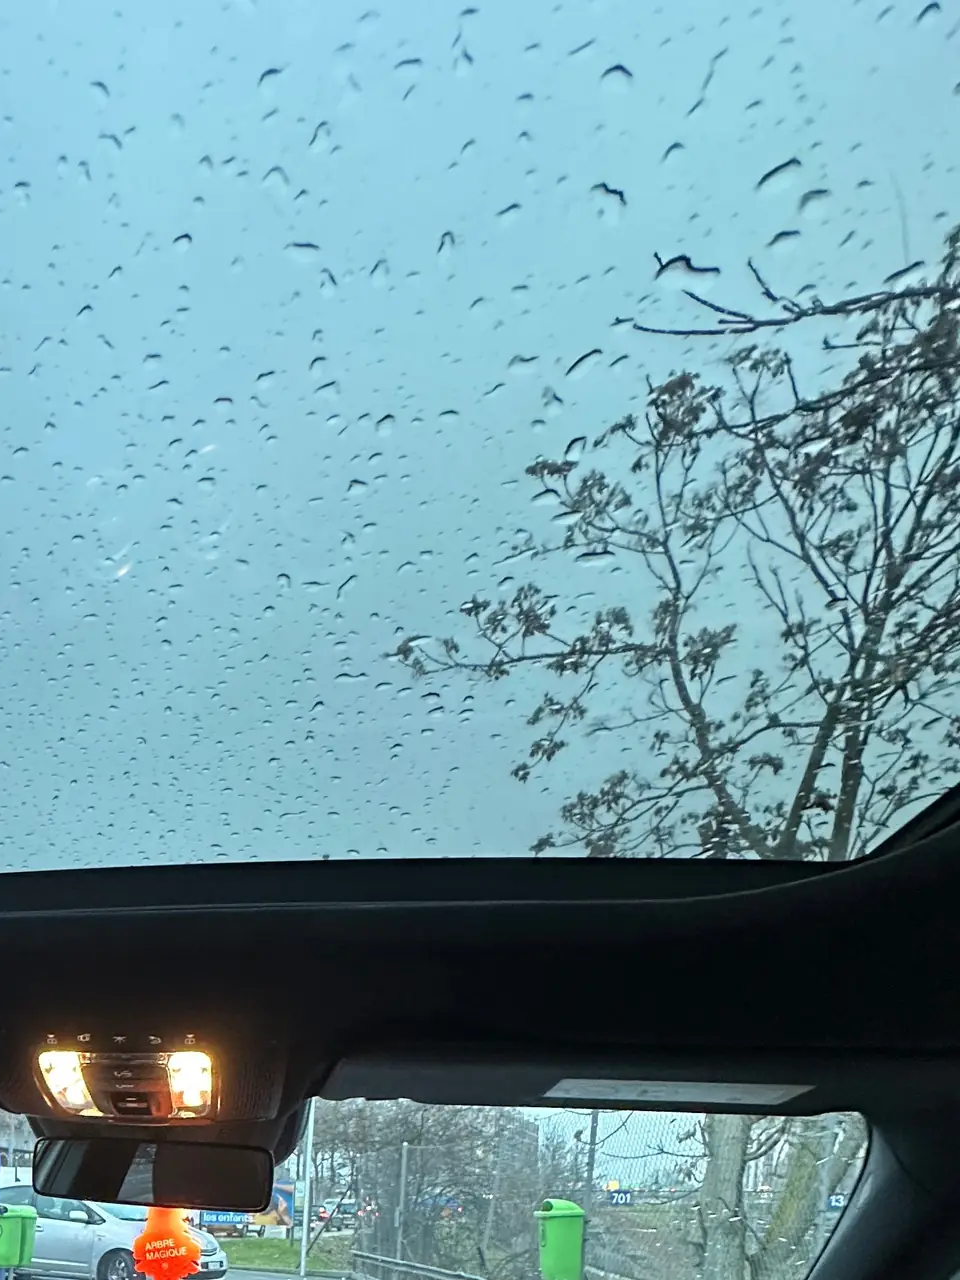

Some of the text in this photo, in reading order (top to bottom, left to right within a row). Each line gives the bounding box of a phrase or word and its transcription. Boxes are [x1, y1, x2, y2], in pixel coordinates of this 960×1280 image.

[611, 1192, 631, 1204] 701
[829, 1194, 845, 1207] 13
[203, 1211, 217, 1222] les
[145, 1238, 175, 1251] ARBRE
[145, 1246, 188, 1260] MAGIQUE
